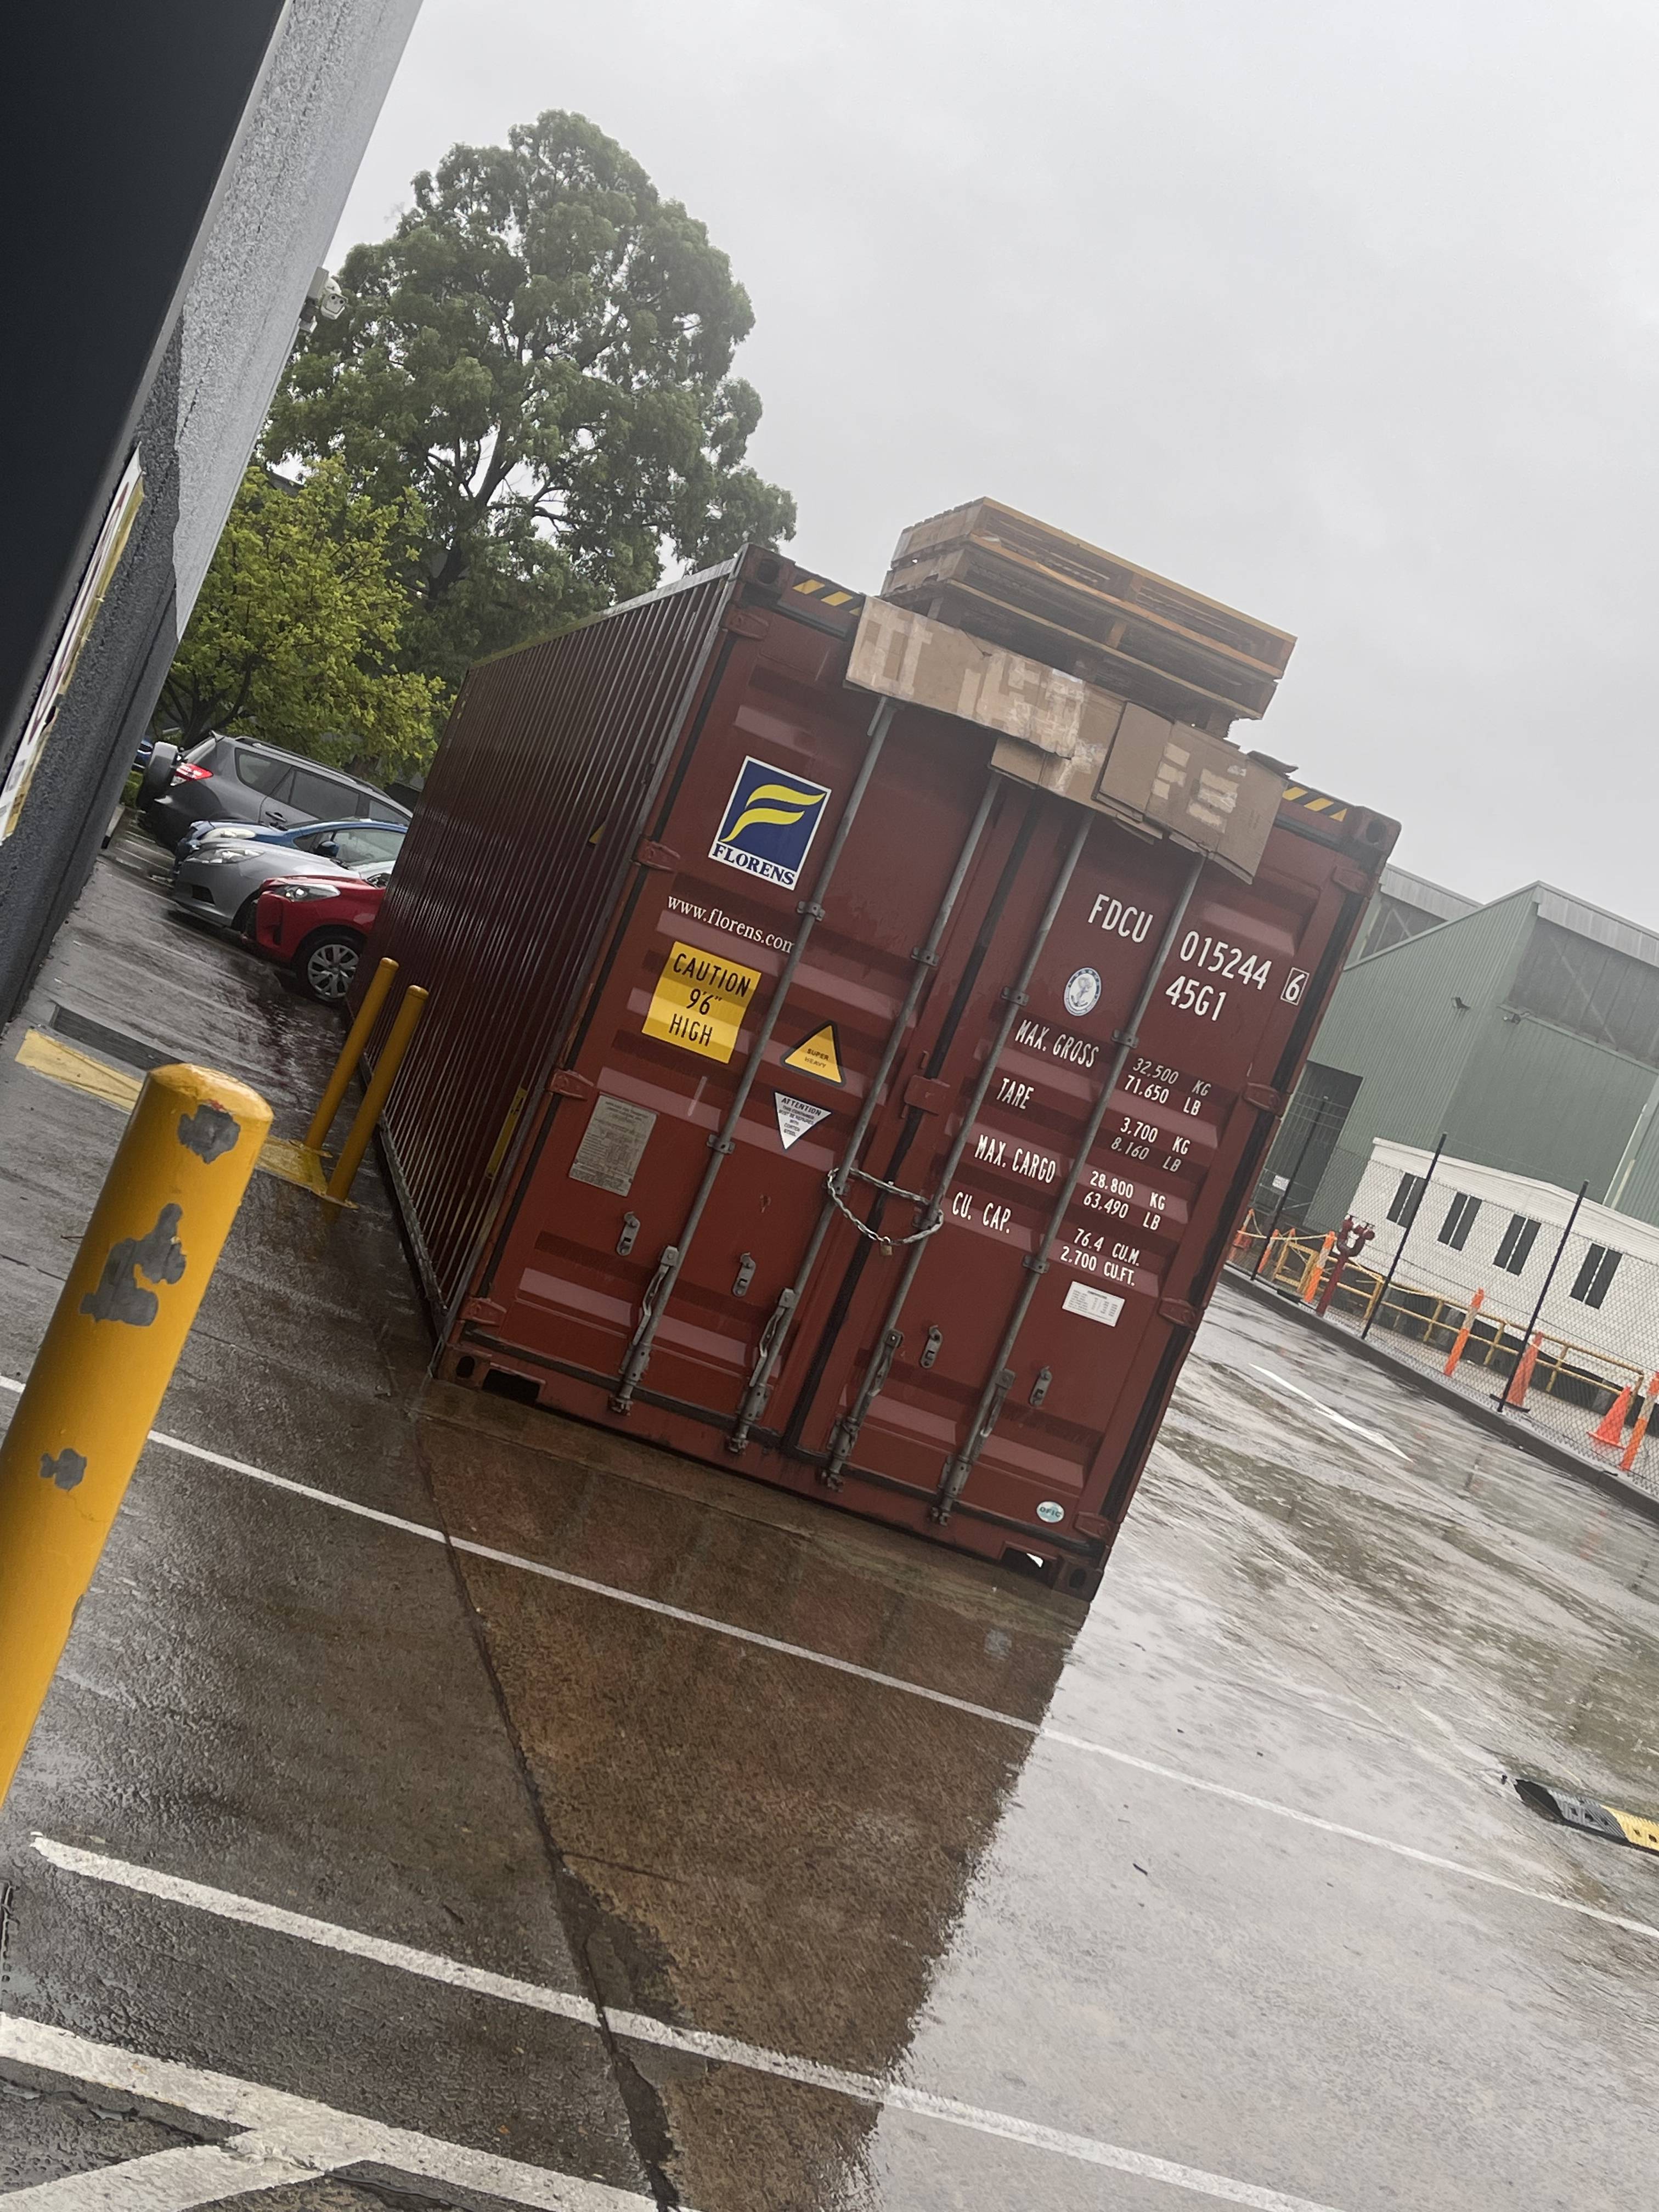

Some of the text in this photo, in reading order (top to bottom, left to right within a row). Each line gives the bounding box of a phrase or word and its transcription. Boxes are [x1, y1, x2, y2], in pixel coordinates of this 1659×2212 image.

[713, 843, 795, 885] FLORENS
[1087, 893, 1306, 1002] FDCU 015244 6
[673, 953, 751, 998] CAUTION
[1165, 975, 1227, 1022] 45G1
[669, 1014, 713, 1047] HIGH
[807, 1048, 829, 1060] SUPER
[1015, 1019, 1047, 1052] MAX.
[1053, 1034, 1099, 1068] GROSS
[1191, 1080, 1212, 1096] KG
[781, 1098, 821, 1116] ATTENTION
[996, 1077, 1035, 1109] TARE
[1172, 1136, 1190, 1155] KG
[1183, 1097, 1201, 1116] LB
[974, 1135, 1007, 1168] MAX.
[1012, 1148, 1056, 1183] CARGO
[1149, 1192, 1166, 1210] KG
[1163, 1155, 1181, 1172] LB
[952, 1192, 972, 1220] CU.
[983, 1202, 1012, 1234] CAP.
[1074, 1228, 1104, 1252] 76.4
[1143, 1212, 1161, 1231] LB
